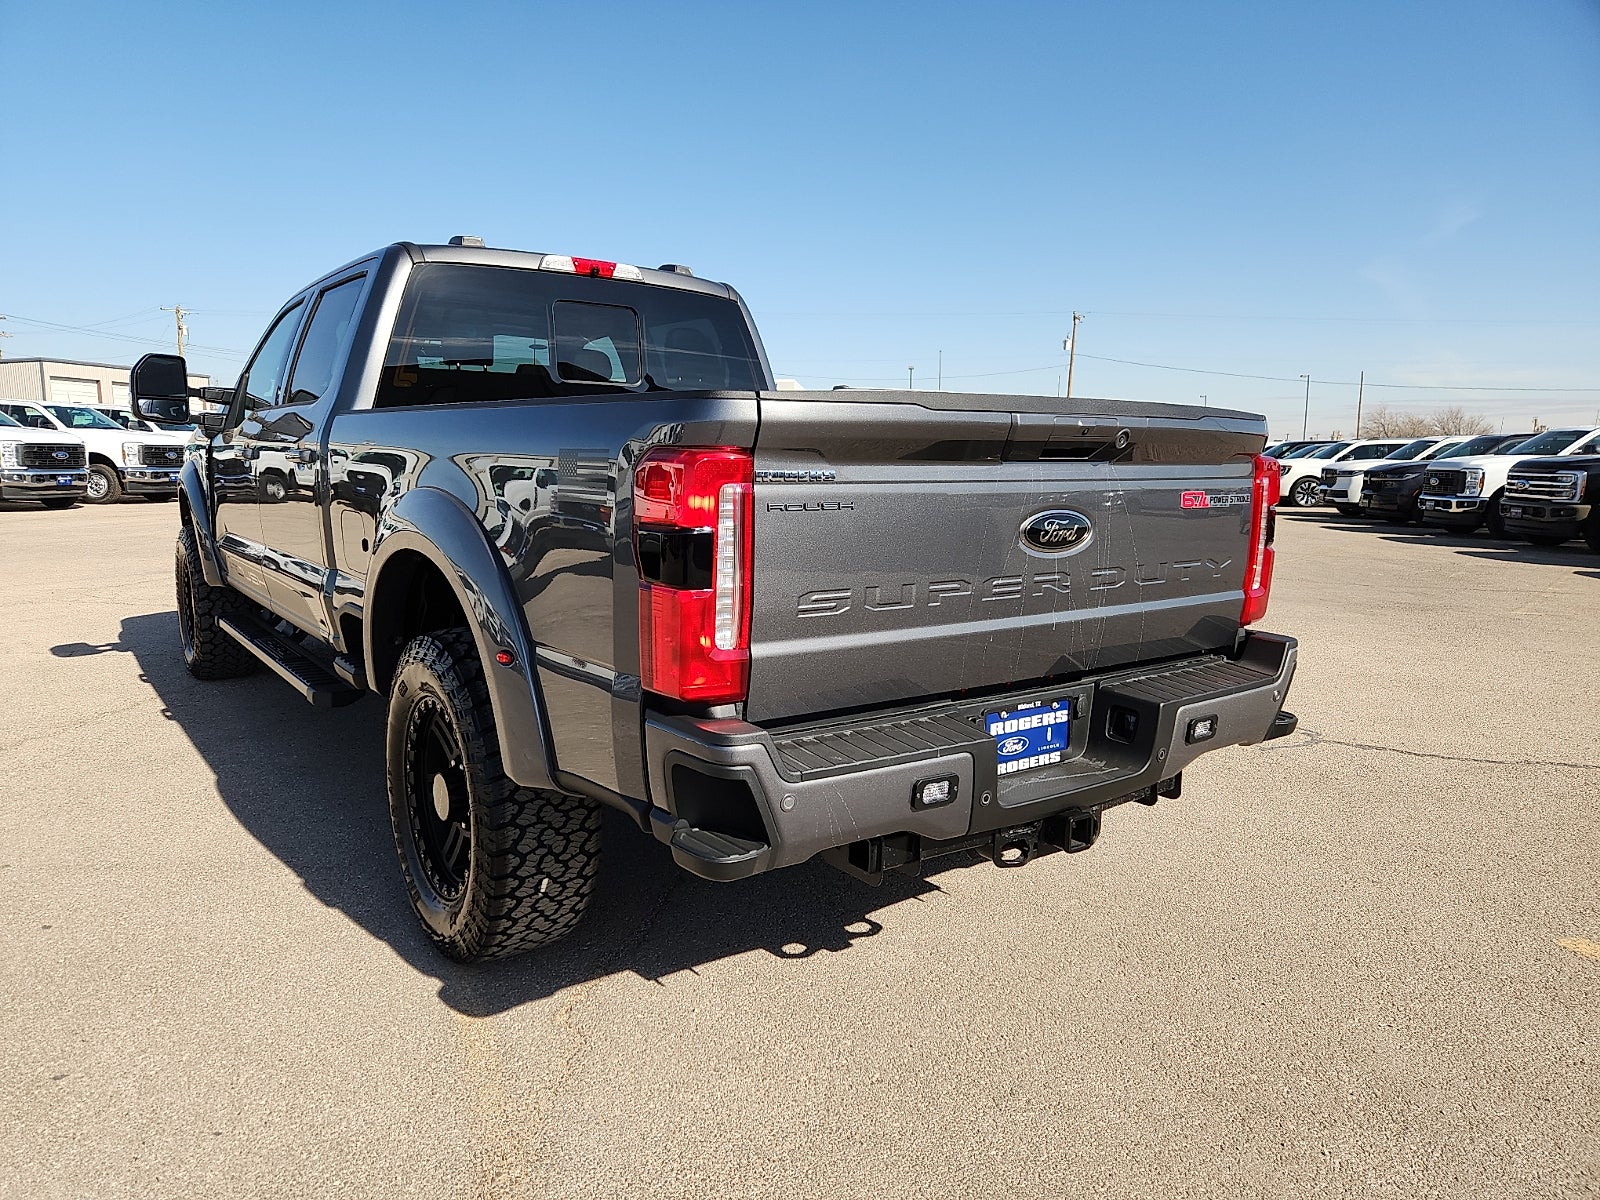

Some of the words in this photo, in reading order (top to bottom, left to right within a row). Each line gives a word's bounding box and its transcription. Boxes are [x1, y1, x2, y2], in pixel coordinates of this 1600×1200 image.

[766, 501, 854, 512] ROUSH
[1209, 495, 1229, 504] POWER
[1230, 495, 1251, 503] STROKE
[1040, 519, 1079, 543] Ford
[798, 571, 1072, 618] SUPER
[1090, 556, 1232, 591] DUTY
[990, 710, 1068, 736] ROGERS
[997, 751, 1061, 775] ROGERS
